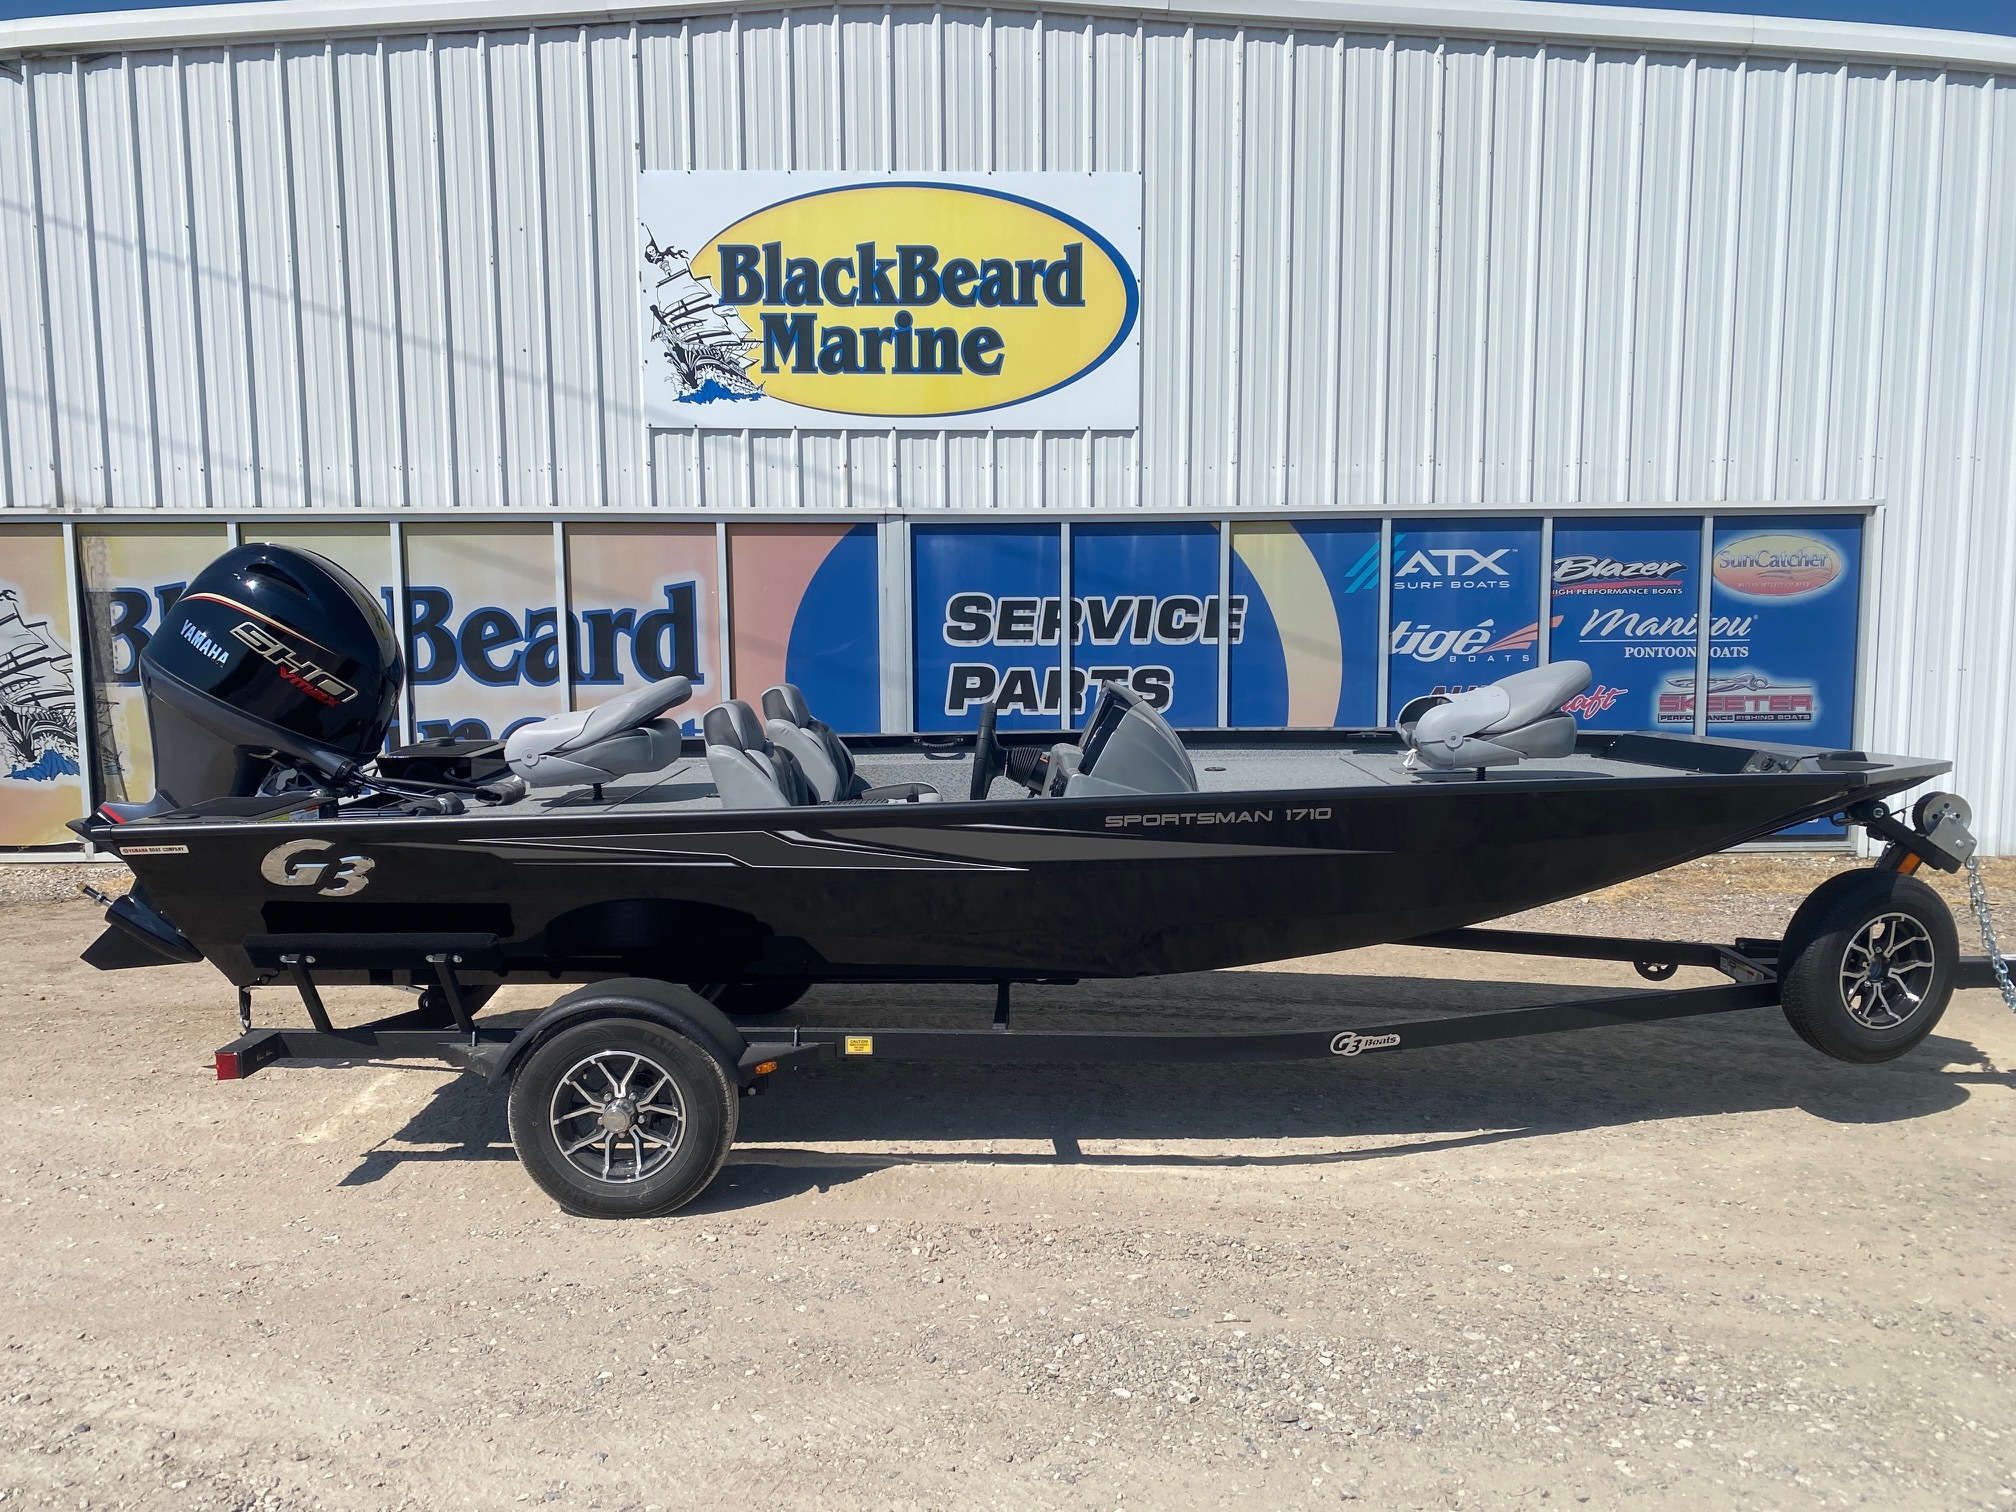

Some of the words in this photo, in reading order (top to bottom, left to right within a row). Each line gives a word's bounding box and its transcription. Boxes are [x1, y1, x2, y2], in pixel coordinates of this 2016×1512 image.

[718, 241, 1086, 308] BlackBeard
[760, 310, 1005, 375] Marine
[1394, 549, 1511, 577] ATX
[1553, 554, 1687, 584] Blazer
[1719, 549, 1829, 569] SunCatcher
[1394, 581, 1443, 589] SURF
[1450, 580, 1510, 589] BOATS
[943, 592, 1248, 646] SERVICE
[1579, 608, 1753, 637] Maniou
[180, 619, 230, 666] YAMAHA
[1390, 618, 1495, 662] tigé
[1624, 646, 1697, 658] PONTOON
[1709, 647, 1749, 658] OATS
[229, 621, 359, 704] SHO
[1449, 654, 1530, 663] BOATS
[944, 662, 1175, 716] PARTS
[1659, 694, 1814, 712] SKEETER
[1104, 809, 1275, 828] SPORTSMAN
[1285, 807, 1333, 821] 1710
[260, 838, 376, 897] G3
[1331, 1033, 1363, 1055] G3
